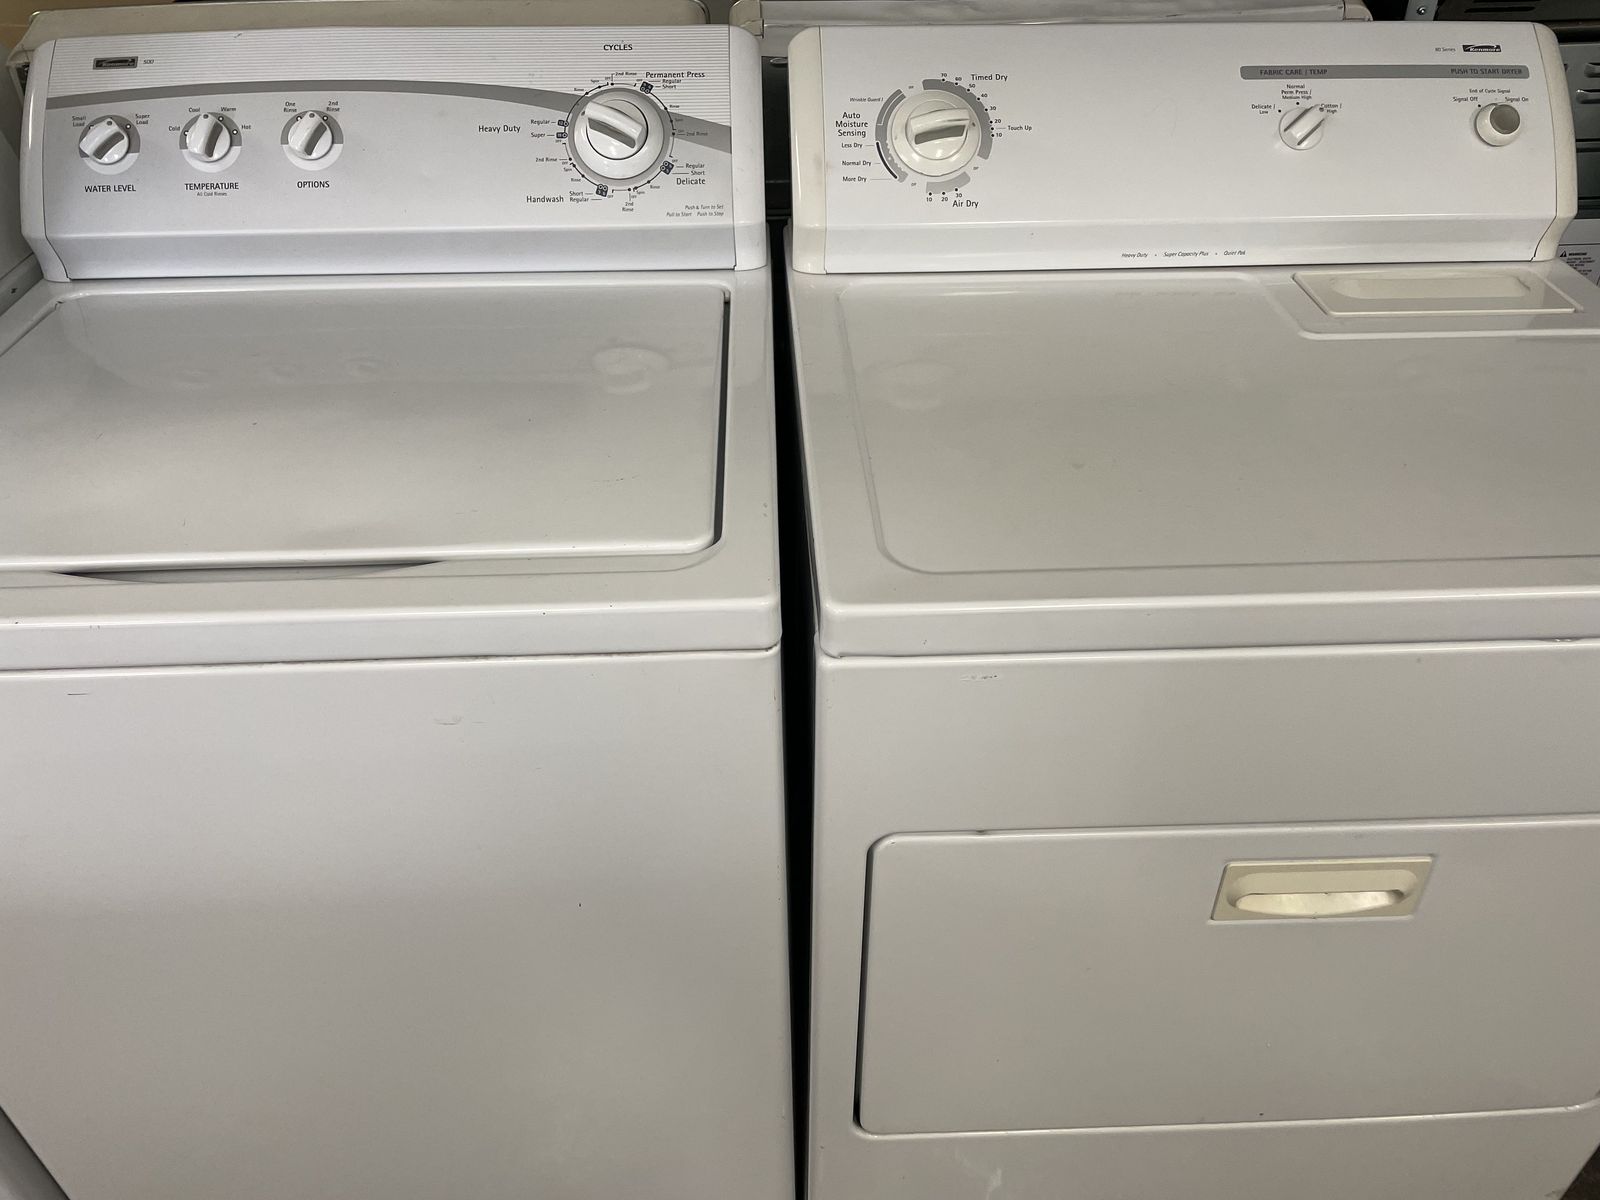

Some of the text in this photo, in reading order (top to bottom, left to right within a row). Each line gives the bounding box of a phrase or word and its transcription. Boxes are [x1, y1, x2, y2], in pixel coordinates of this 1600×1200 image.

[645, 71, 684, 79] Permanent
[971, 73, 1008, 82] Timed Dry
[842, 111, 861, 119] Auto
[835, 120, 868, 128] Moisture
[478, 124, 521, 134] Heavy Duty
[837, 129, 866, 138] Sensing
[296, 180, 330, 189] OPTIONS
[676, 177, 706, 185] Delicate
[84, 184, 136, 193] WATER LEVEL
[184, 182, 239, 190] TEMPERATURE
[526, 195, 564, 203] Handwash
[966, 199, 979, 208] Dry
